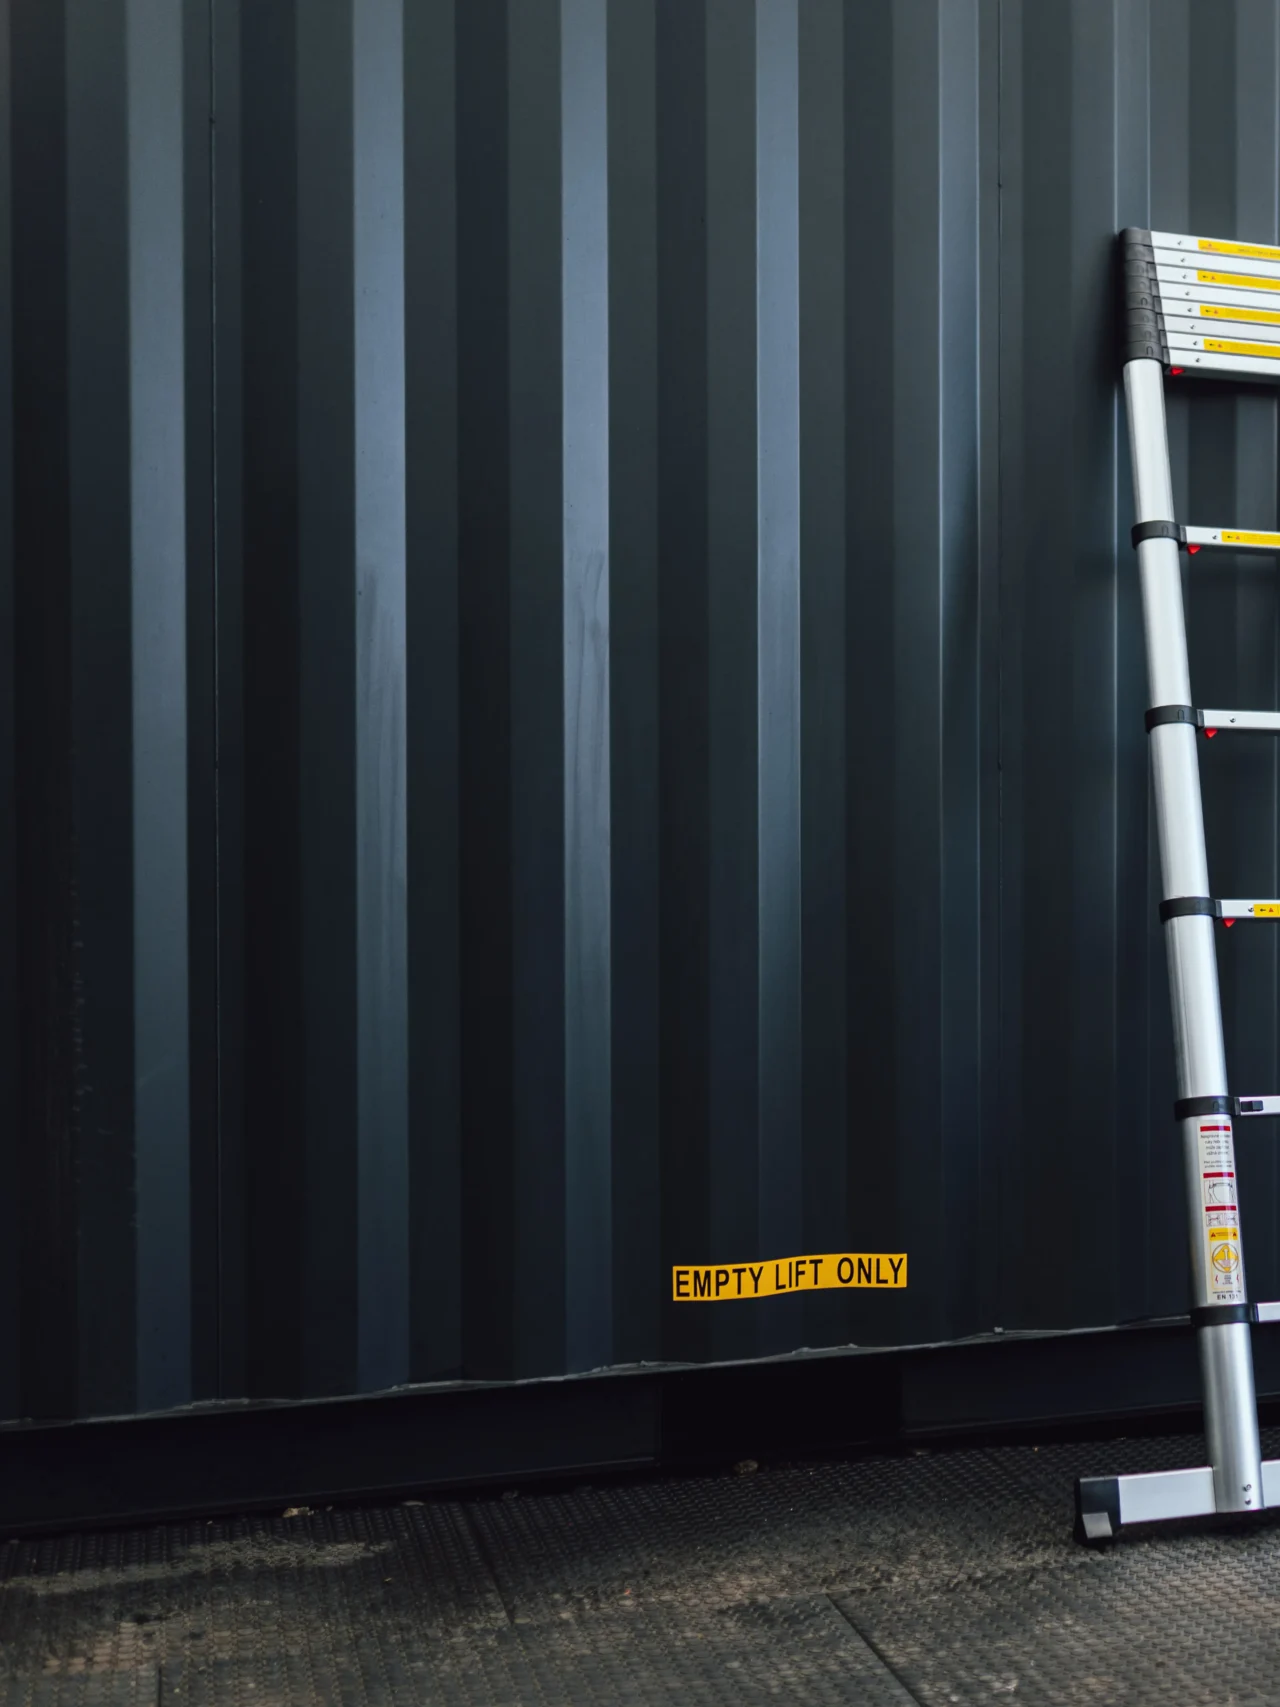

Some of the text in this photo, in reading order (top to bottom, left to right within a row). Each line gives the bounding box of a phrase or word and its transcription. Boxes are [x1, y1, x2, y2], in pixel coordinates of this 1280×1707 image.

[676, 1257, 904, 1297] EMPTY LIFT ONLY
